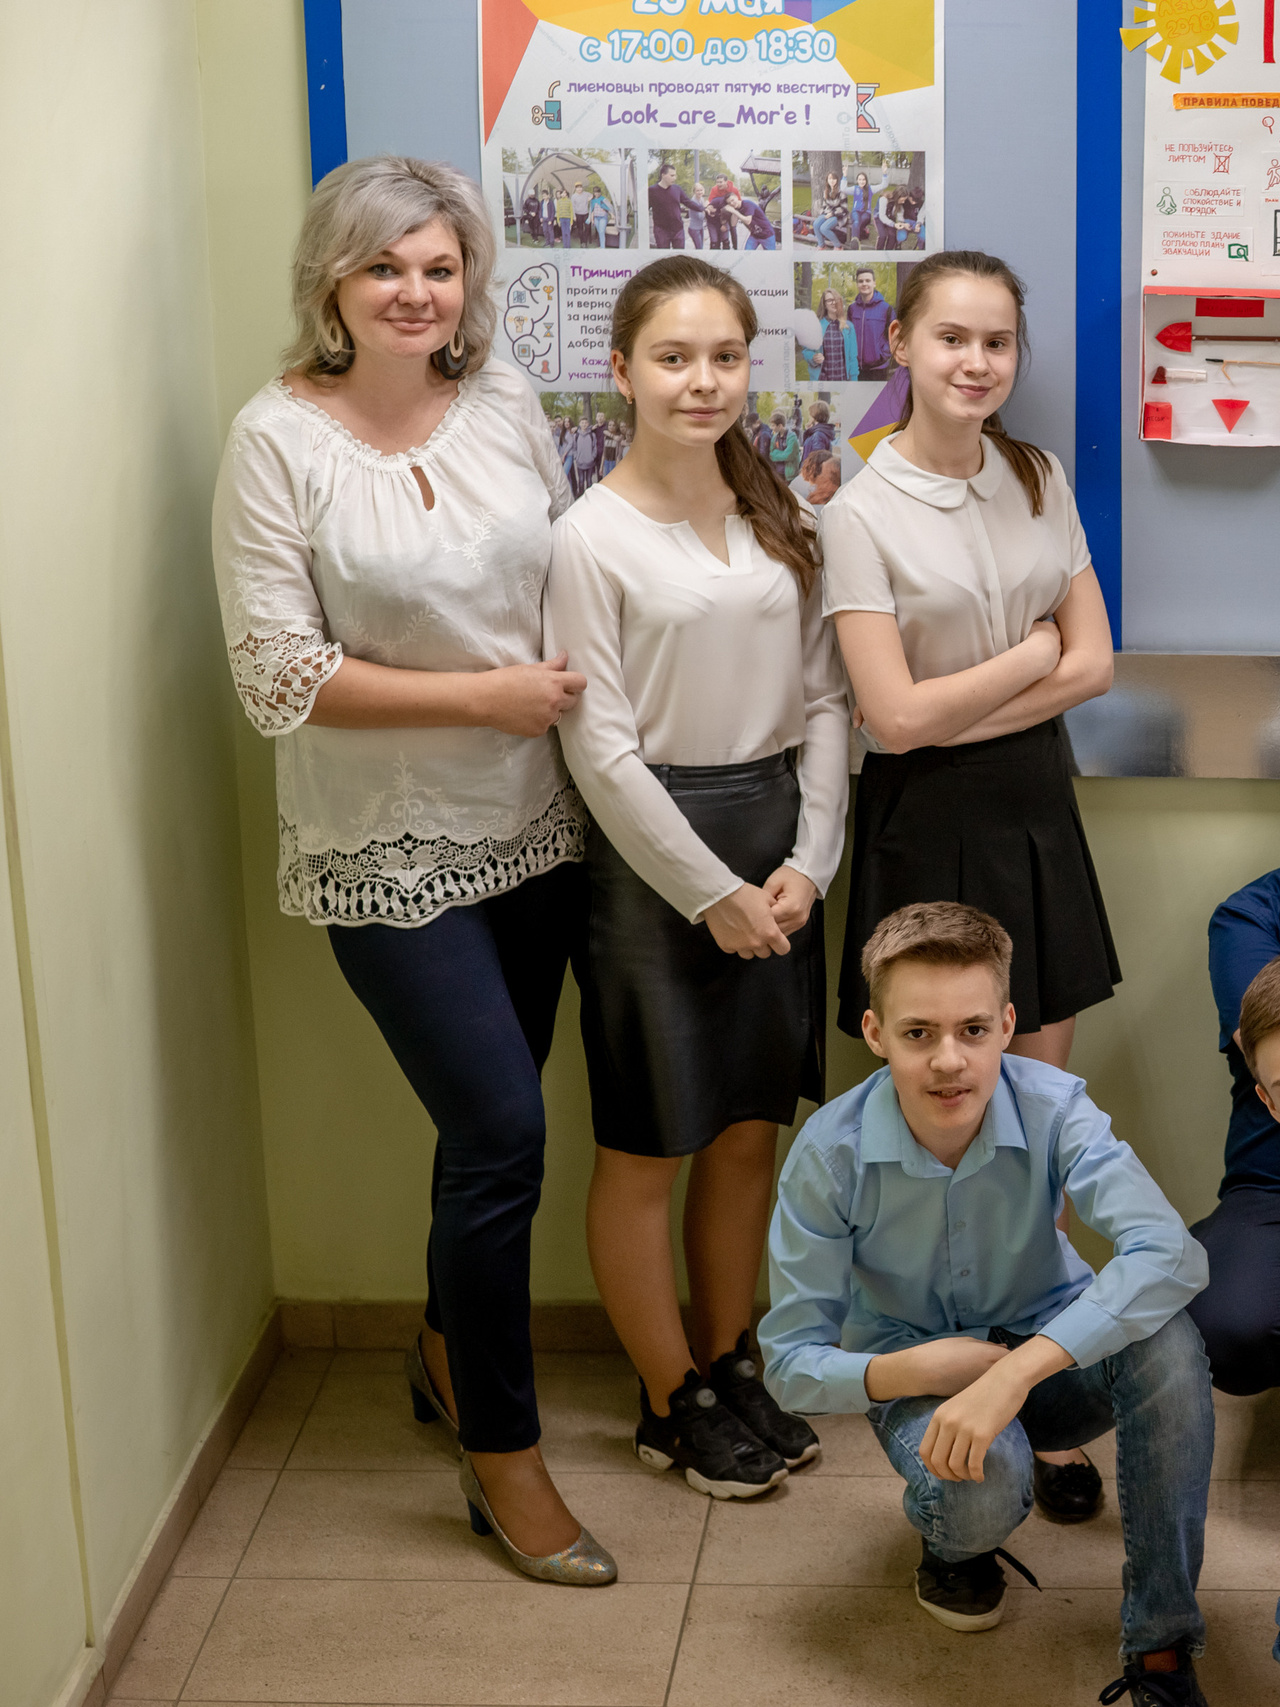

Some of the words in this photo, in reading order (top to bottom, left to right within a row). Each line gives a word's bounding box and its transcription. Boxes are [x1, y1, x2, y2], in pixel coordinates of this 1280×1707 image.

[1166, 11, 1215, 39] 2018
[580, 37, 601, 62] с
[607, 29, 694, 63] 17:00
[701, 37, 747, 65] до
[755, 29, 837, 64] 18:30
[567, 82, 644, 95] лиеновцы
[649, 81, 720, 97] проводят
[724, 81, 771, 96] пятую
[776, 82, 851, 98] квестигру
[1183, 97, 1238, 108] ПРАВИЛА
[1165, 144, 1175, 152] НЕ
[1178, 142, 1234, 152] ПОЛЬЗУЙТЕСЬ
[1168, 154, 1206, 163] ЛИФТОМ
[1184, 188, 1241, 198] СОБЛЮДАЙТЕ
[1183, 198, 1233, 206] СПОКОЙСТВИЕ
[1182, 206, 1217, 216] ПОРЯДОК
[1163, 231, 1206, 239] ПОКИНЬТЕ
[1211, 231, 1241, 240] ЗДАНИЕ
[1200, 241, 1225, 249] ПЛАНУ
[1163, 248, 1210, 257] ЭВАКУАЦИИ
[570, 265, 632, 281] Принцип
[567, 285, 607, 296] пройти
[746, 289, 789, 298] окации
[577, 301, 612, 310] верно
[580, 325, 609, 335] Побе
[756, 328, 788, 337] учики
[567, 338, 604, 349] добра
[582, 357, 609, 366] Кажд
[568, 372, 613, 381] участни
